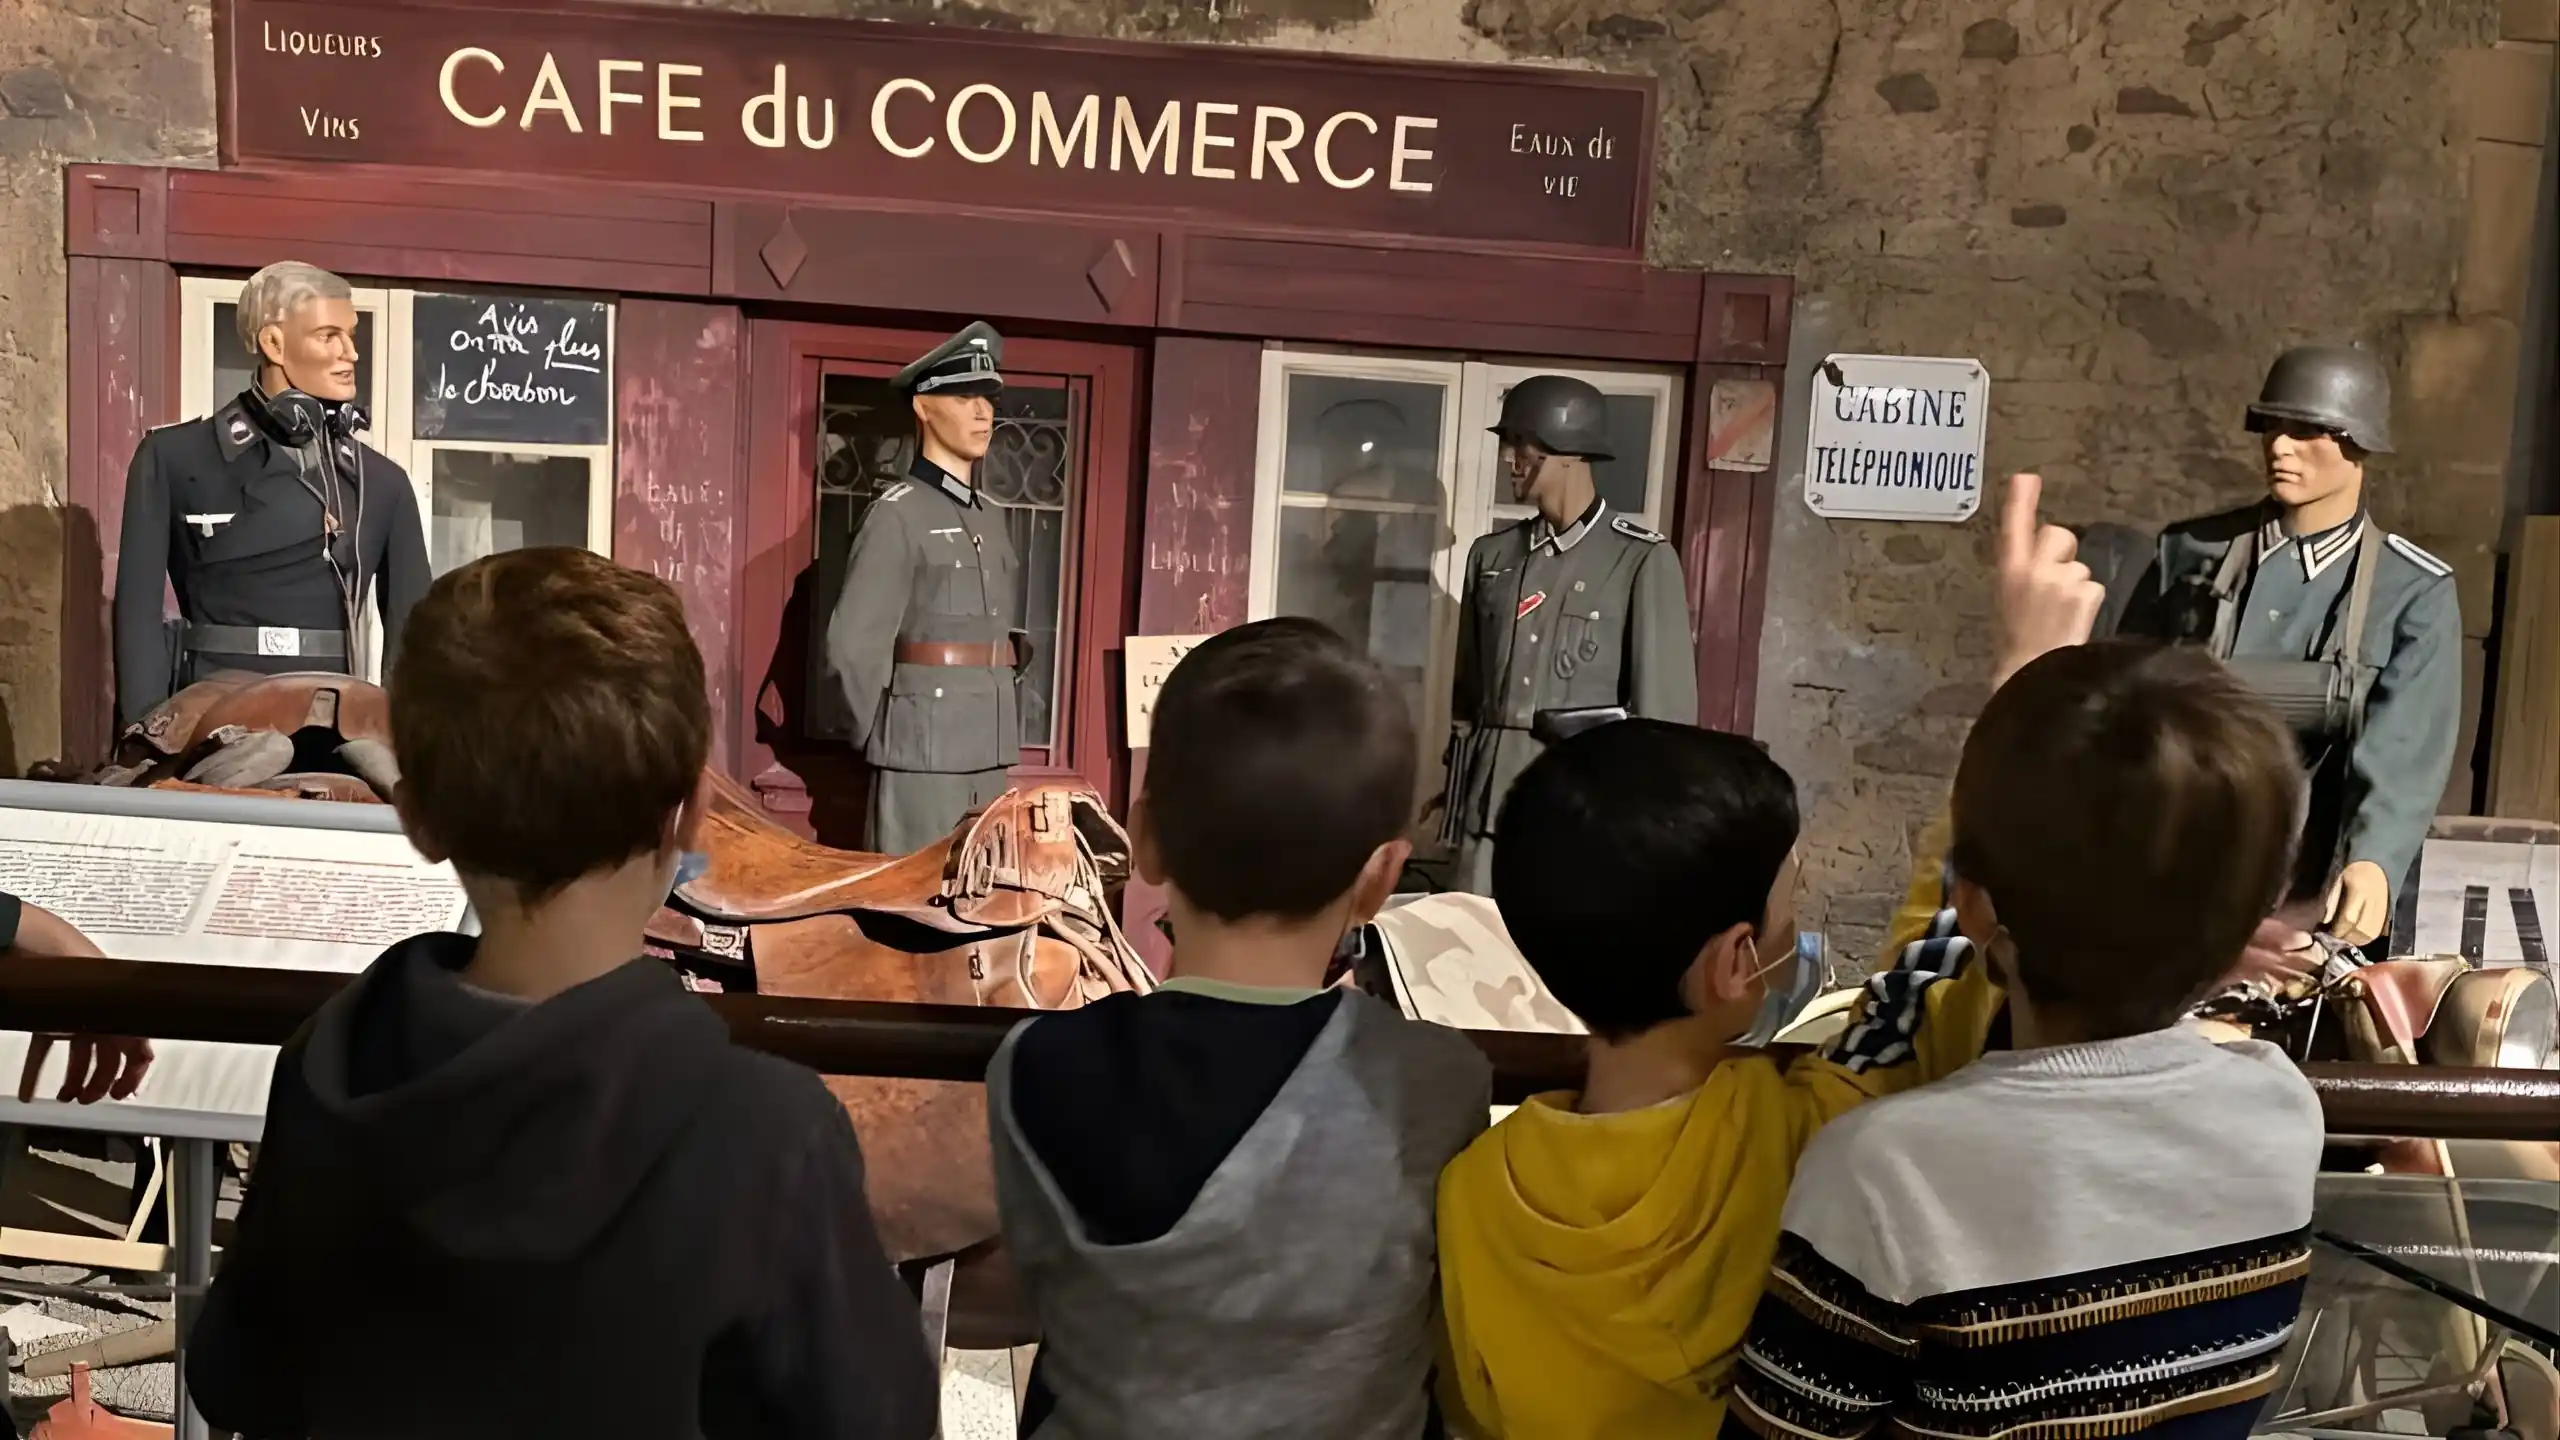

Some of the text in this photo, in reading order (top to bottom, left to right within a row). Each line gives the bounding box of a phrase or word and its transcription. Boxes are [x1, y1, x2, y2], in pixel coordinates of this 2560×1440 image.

[438, 46, 1439, 192] CAFE du COMMERCE
[1835, 384, 1966, 428] CABINE
[1814, 440, 1977, 491] TÉLÉPHONIQUE
